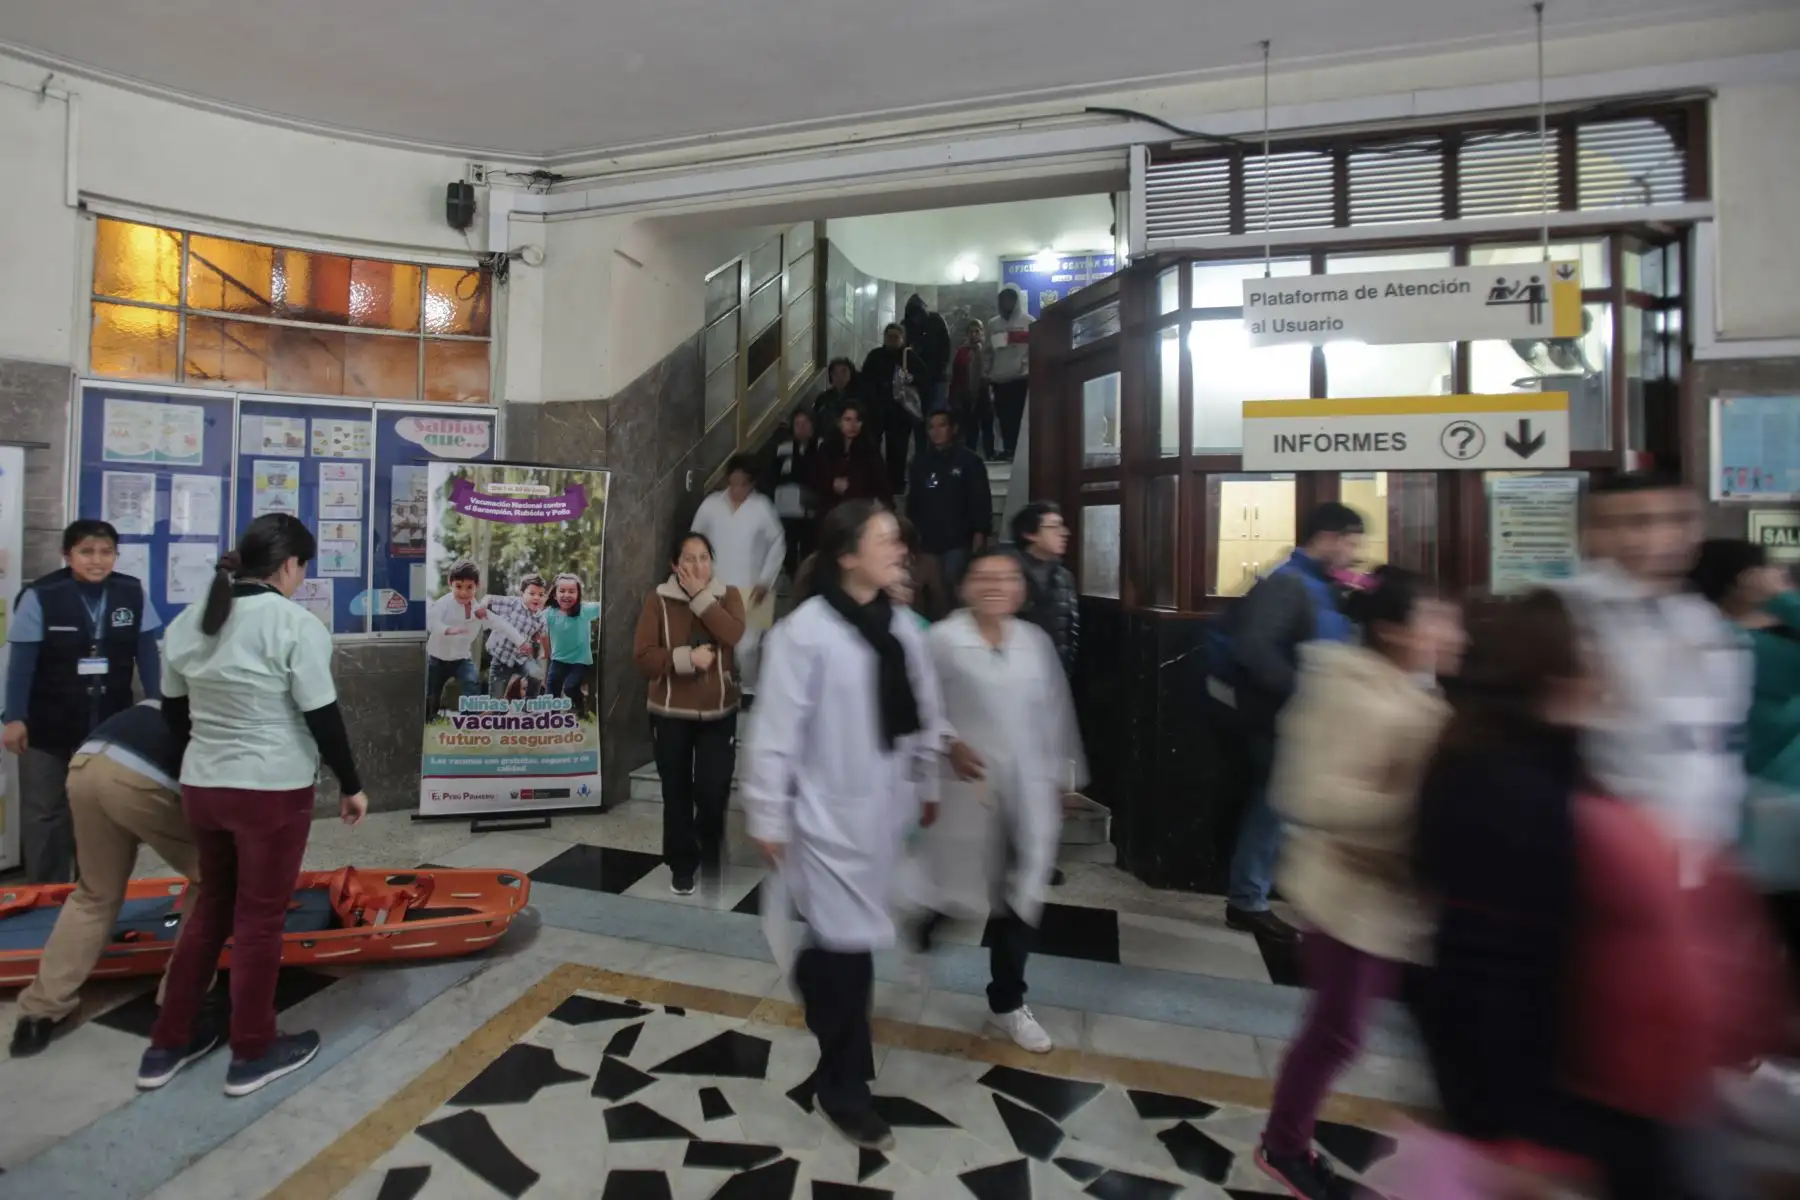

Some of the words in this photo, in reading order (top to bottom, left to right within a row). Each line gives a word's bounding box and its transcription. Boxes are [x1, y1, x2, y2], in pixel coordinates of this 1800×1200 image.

[1249, 288, 1349, 308] Plataforma
[1355, 284, 1378, 301] de
[1384, 277, 1471, 298] Atención
[1251, 319, 1267, 334] al
[1272, 316, 1344, 334] Usuario
[1273, 432, 1407, 453] INFORMES
[470, 496, 511, 508] Vacunación
[512, 501, 543, 509] Nacional
[543, 501, 567, 509] contra
[514, 508, 545, 517] Rubéola
[552, 508, 572, 516] Polio
[459, 695, 508, 711] Niñas
[510, 699, 524, 712] y
[527, 694, 572, 711] niños
[438, 732, 492, 746] futuro
[499, 731, 584, 748] asegurado
